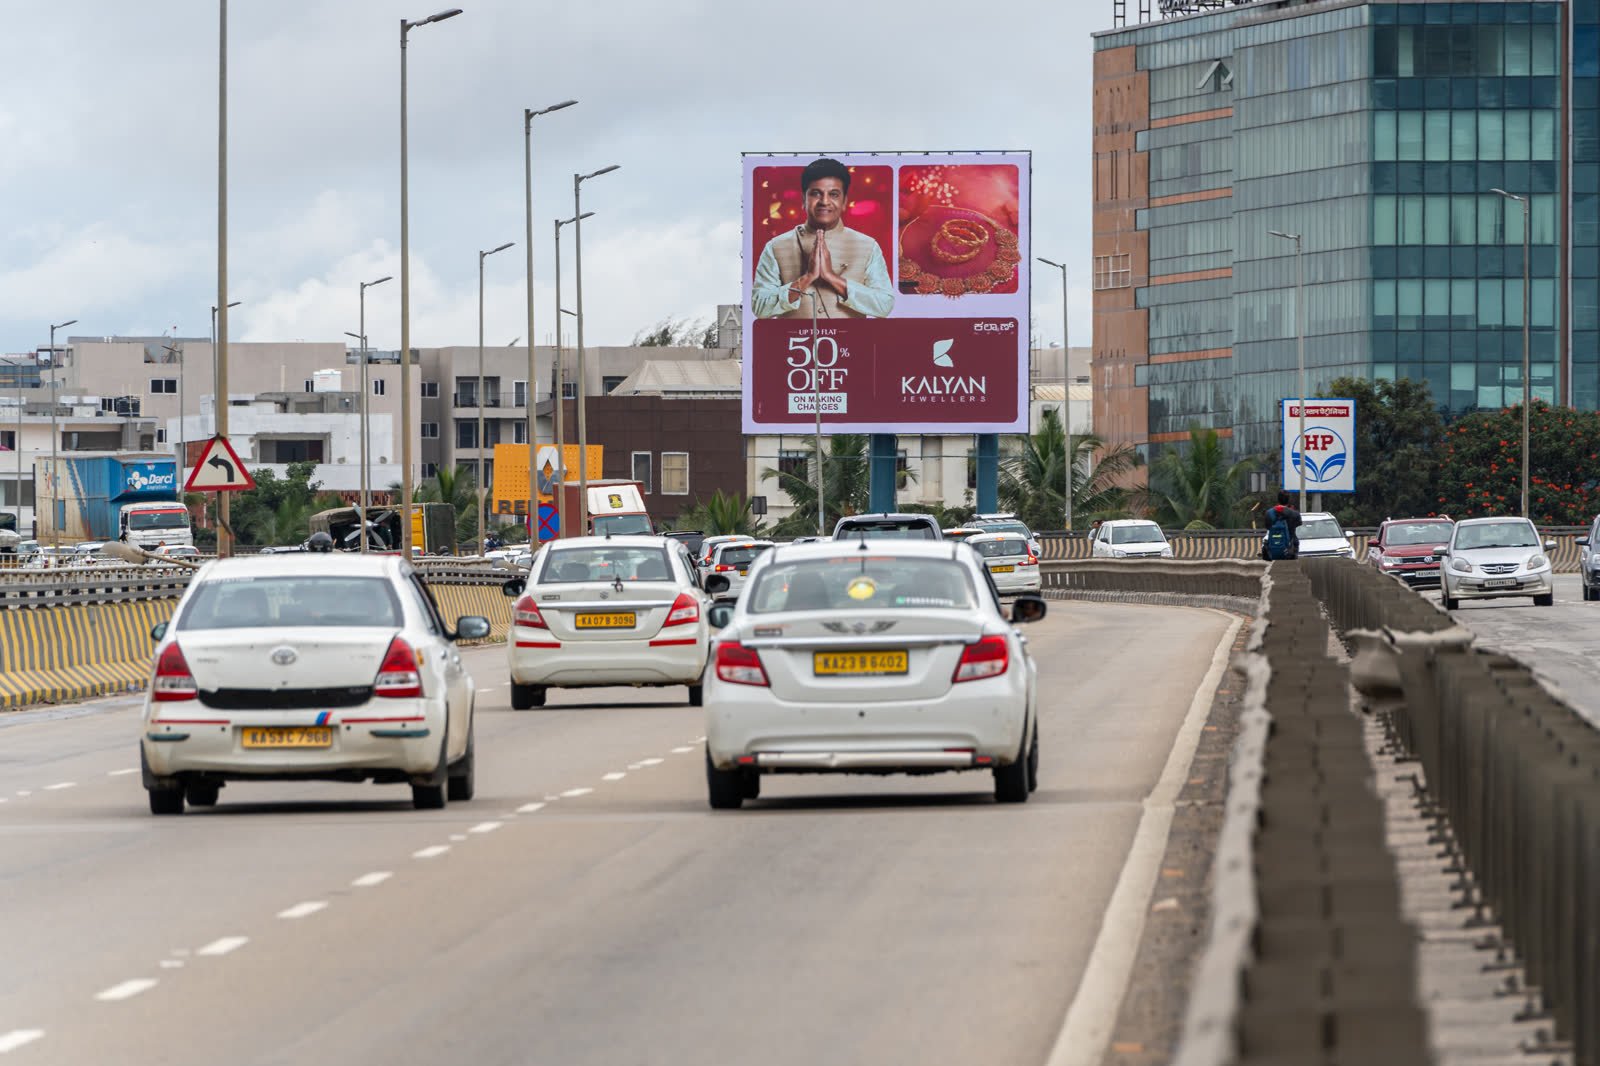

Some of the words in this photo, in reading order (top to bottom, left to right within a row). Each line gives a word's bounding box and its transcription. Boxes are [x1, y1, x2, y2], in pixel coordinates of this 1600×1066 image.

[787, 368, 848, 391] OFF
[902, 376, 986, 394] KALYAN
[1304, 434, 1334, 451] HP
